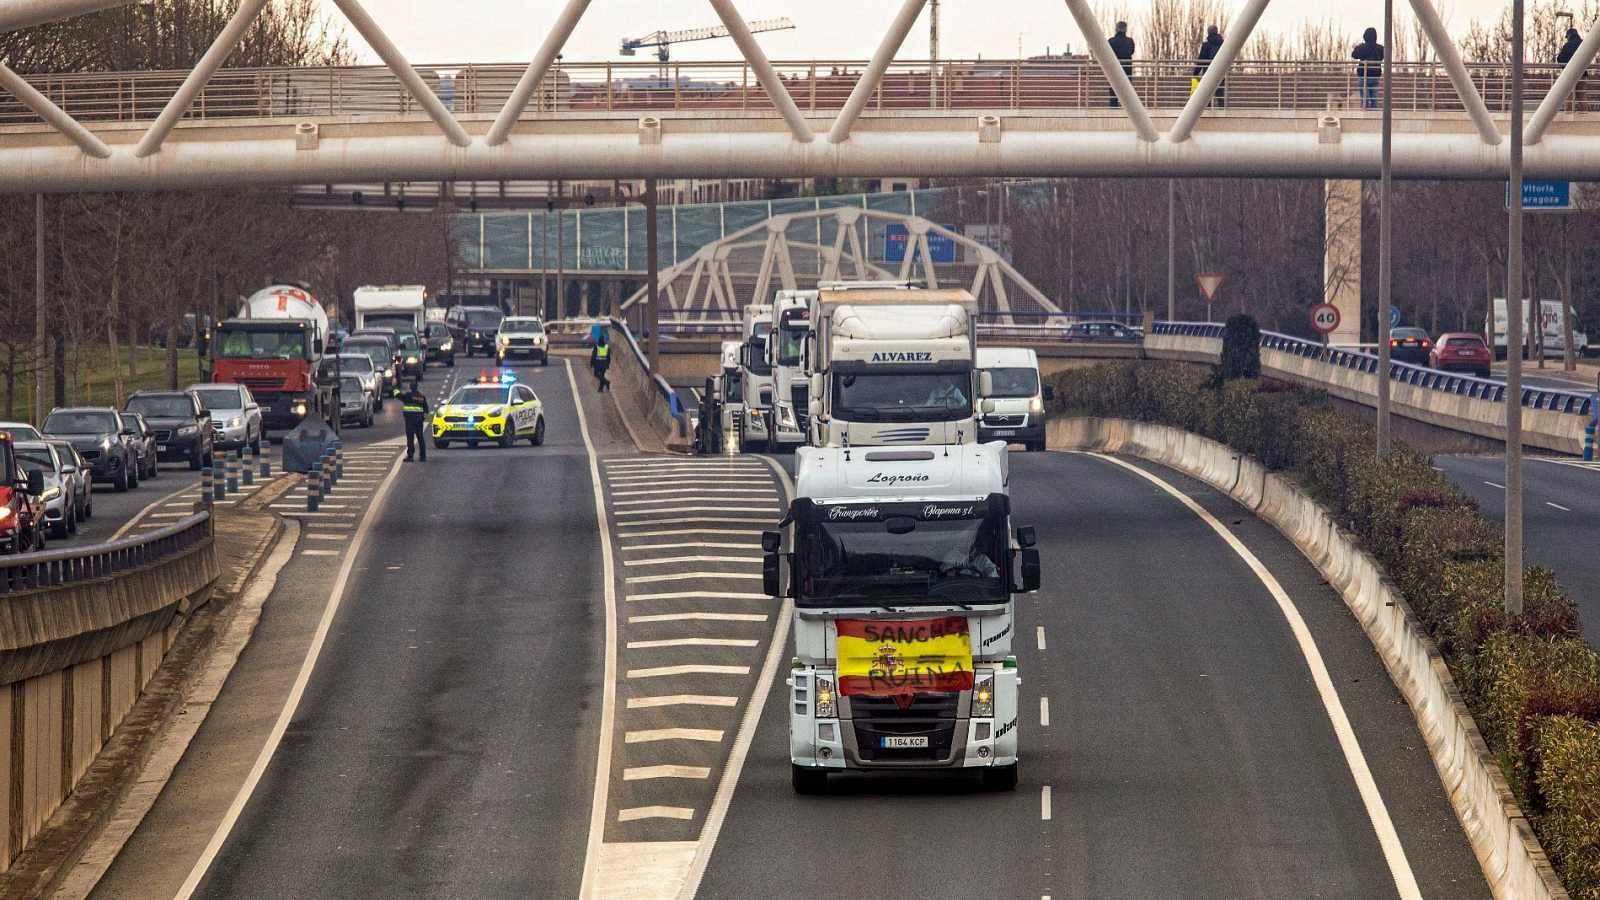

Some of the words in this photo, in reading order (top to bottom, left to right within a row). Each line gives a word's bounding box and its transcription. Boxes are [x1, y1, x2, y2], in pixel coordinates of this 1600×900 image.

[1523, 184, 1555, 193] Vitoria
[1522, 196, 1560, 205] aragoza
[1316, 312, 1335, 324] 40
[872, 352, 932, 361] ALVAREZ
[867, 472, 930, 485] Logroño
[868, 661, 969, 691] RUINA
[888, 737, 908, 746] 1164
[909, 737, 925, 746] KCP
